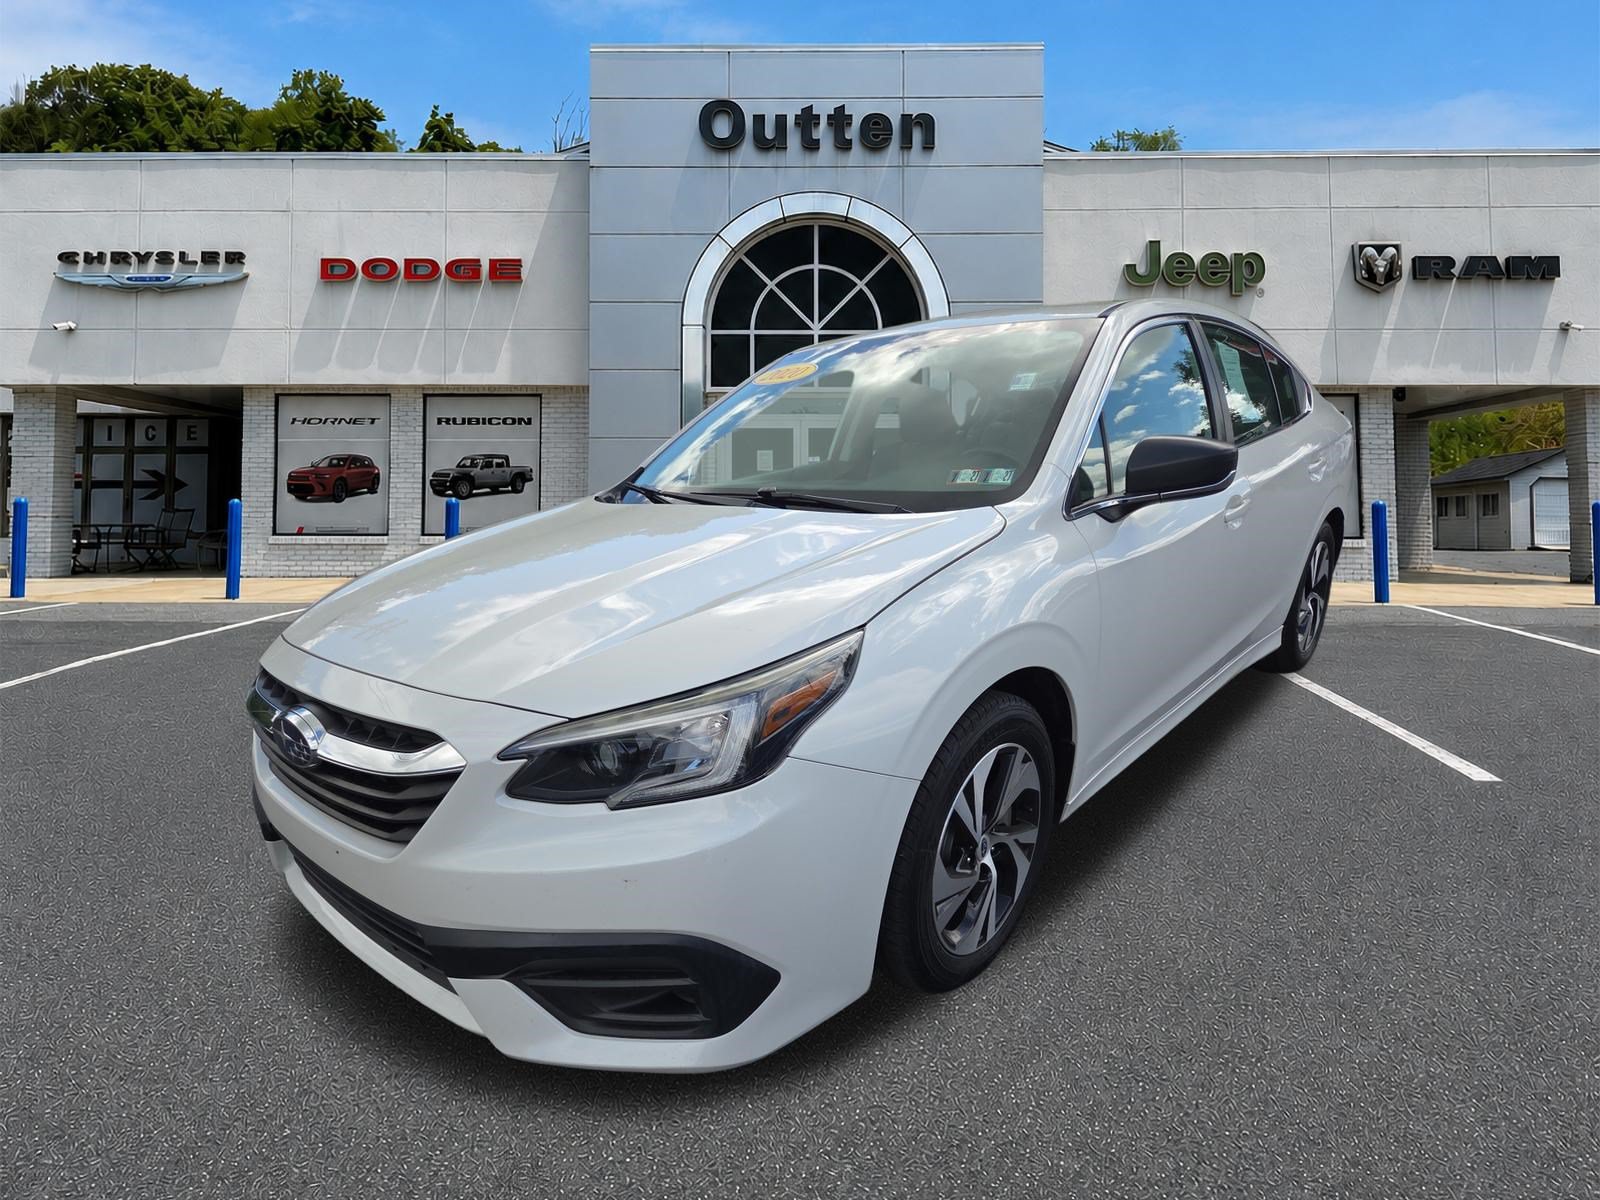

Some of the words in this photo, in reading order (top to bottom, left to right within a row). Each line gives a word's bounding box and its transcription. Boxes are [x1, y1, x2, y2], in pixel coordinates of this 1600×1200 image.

[698, 98, 936, 152] Outten
[57, 250, 247, 266] CHRYSLER
[320, 257, 523, 282] DODGE
[1123, 239, 1266, 296] Jeep
[1412, 254, 1561, 281] RAM
[290, 416, 381, 426] HORNET
[436, 416, 533, 426] RUBICON
